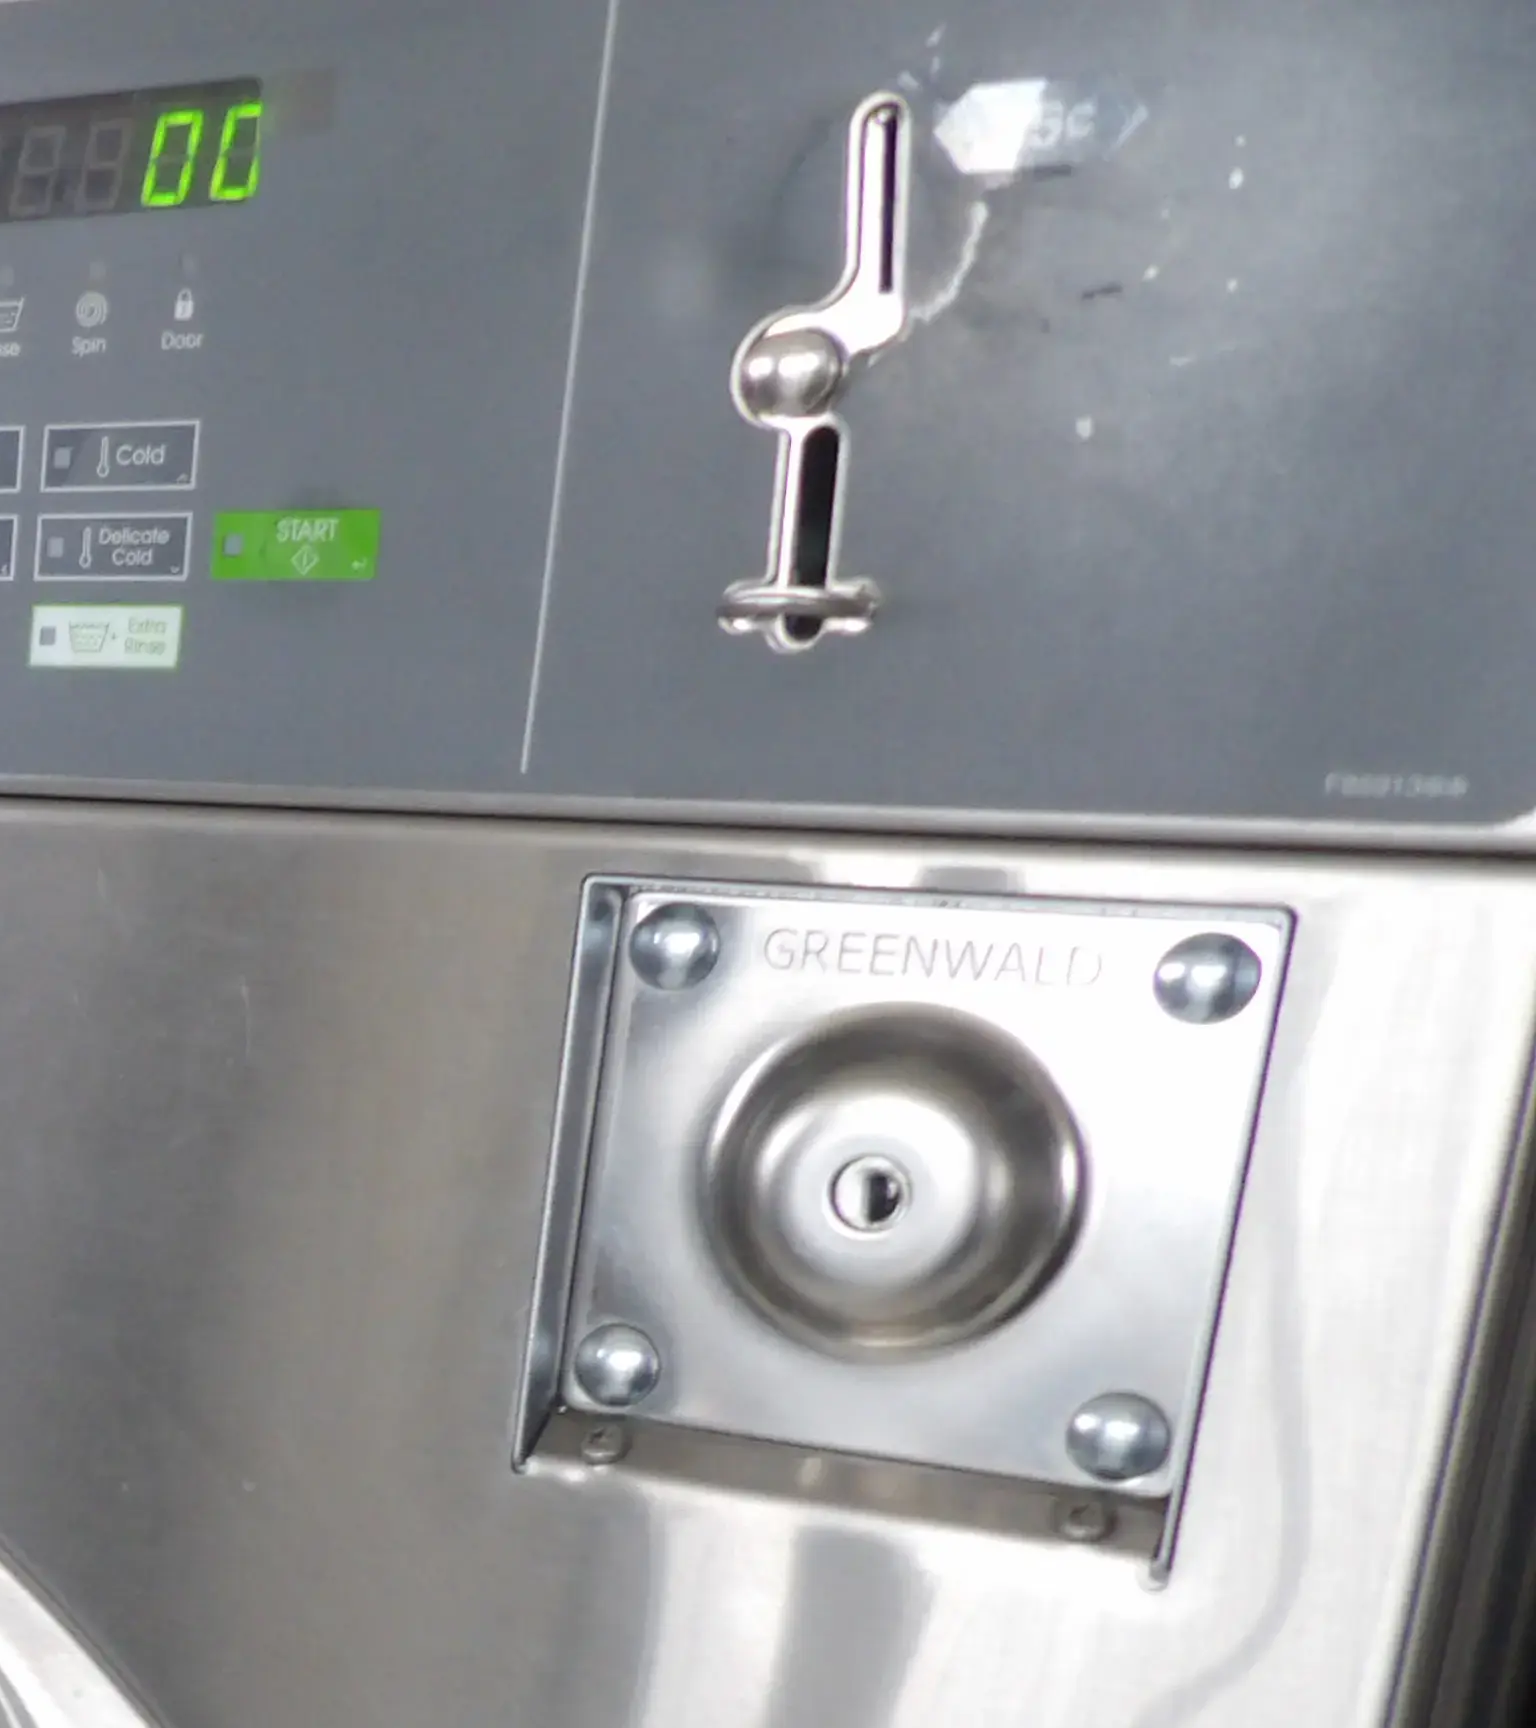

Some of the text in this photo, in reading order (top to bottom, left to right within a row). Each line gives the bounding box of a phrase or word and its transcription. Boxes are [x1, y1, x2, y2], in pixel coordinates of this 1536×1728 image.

[72, 336, 106, 357] Spin
[161, 330, 204, 351] Door
[115, 444, 166, 466] Cold
[99, 526, 171, 546] Delicate
[276, 516, 341, 543] START
[111, 547, 154, 567] Cold
[127, 616, 167, 636] Extra
[124, 636, 167, 656] Rinse
[763, 927, 1103, 986] GREENWALD
